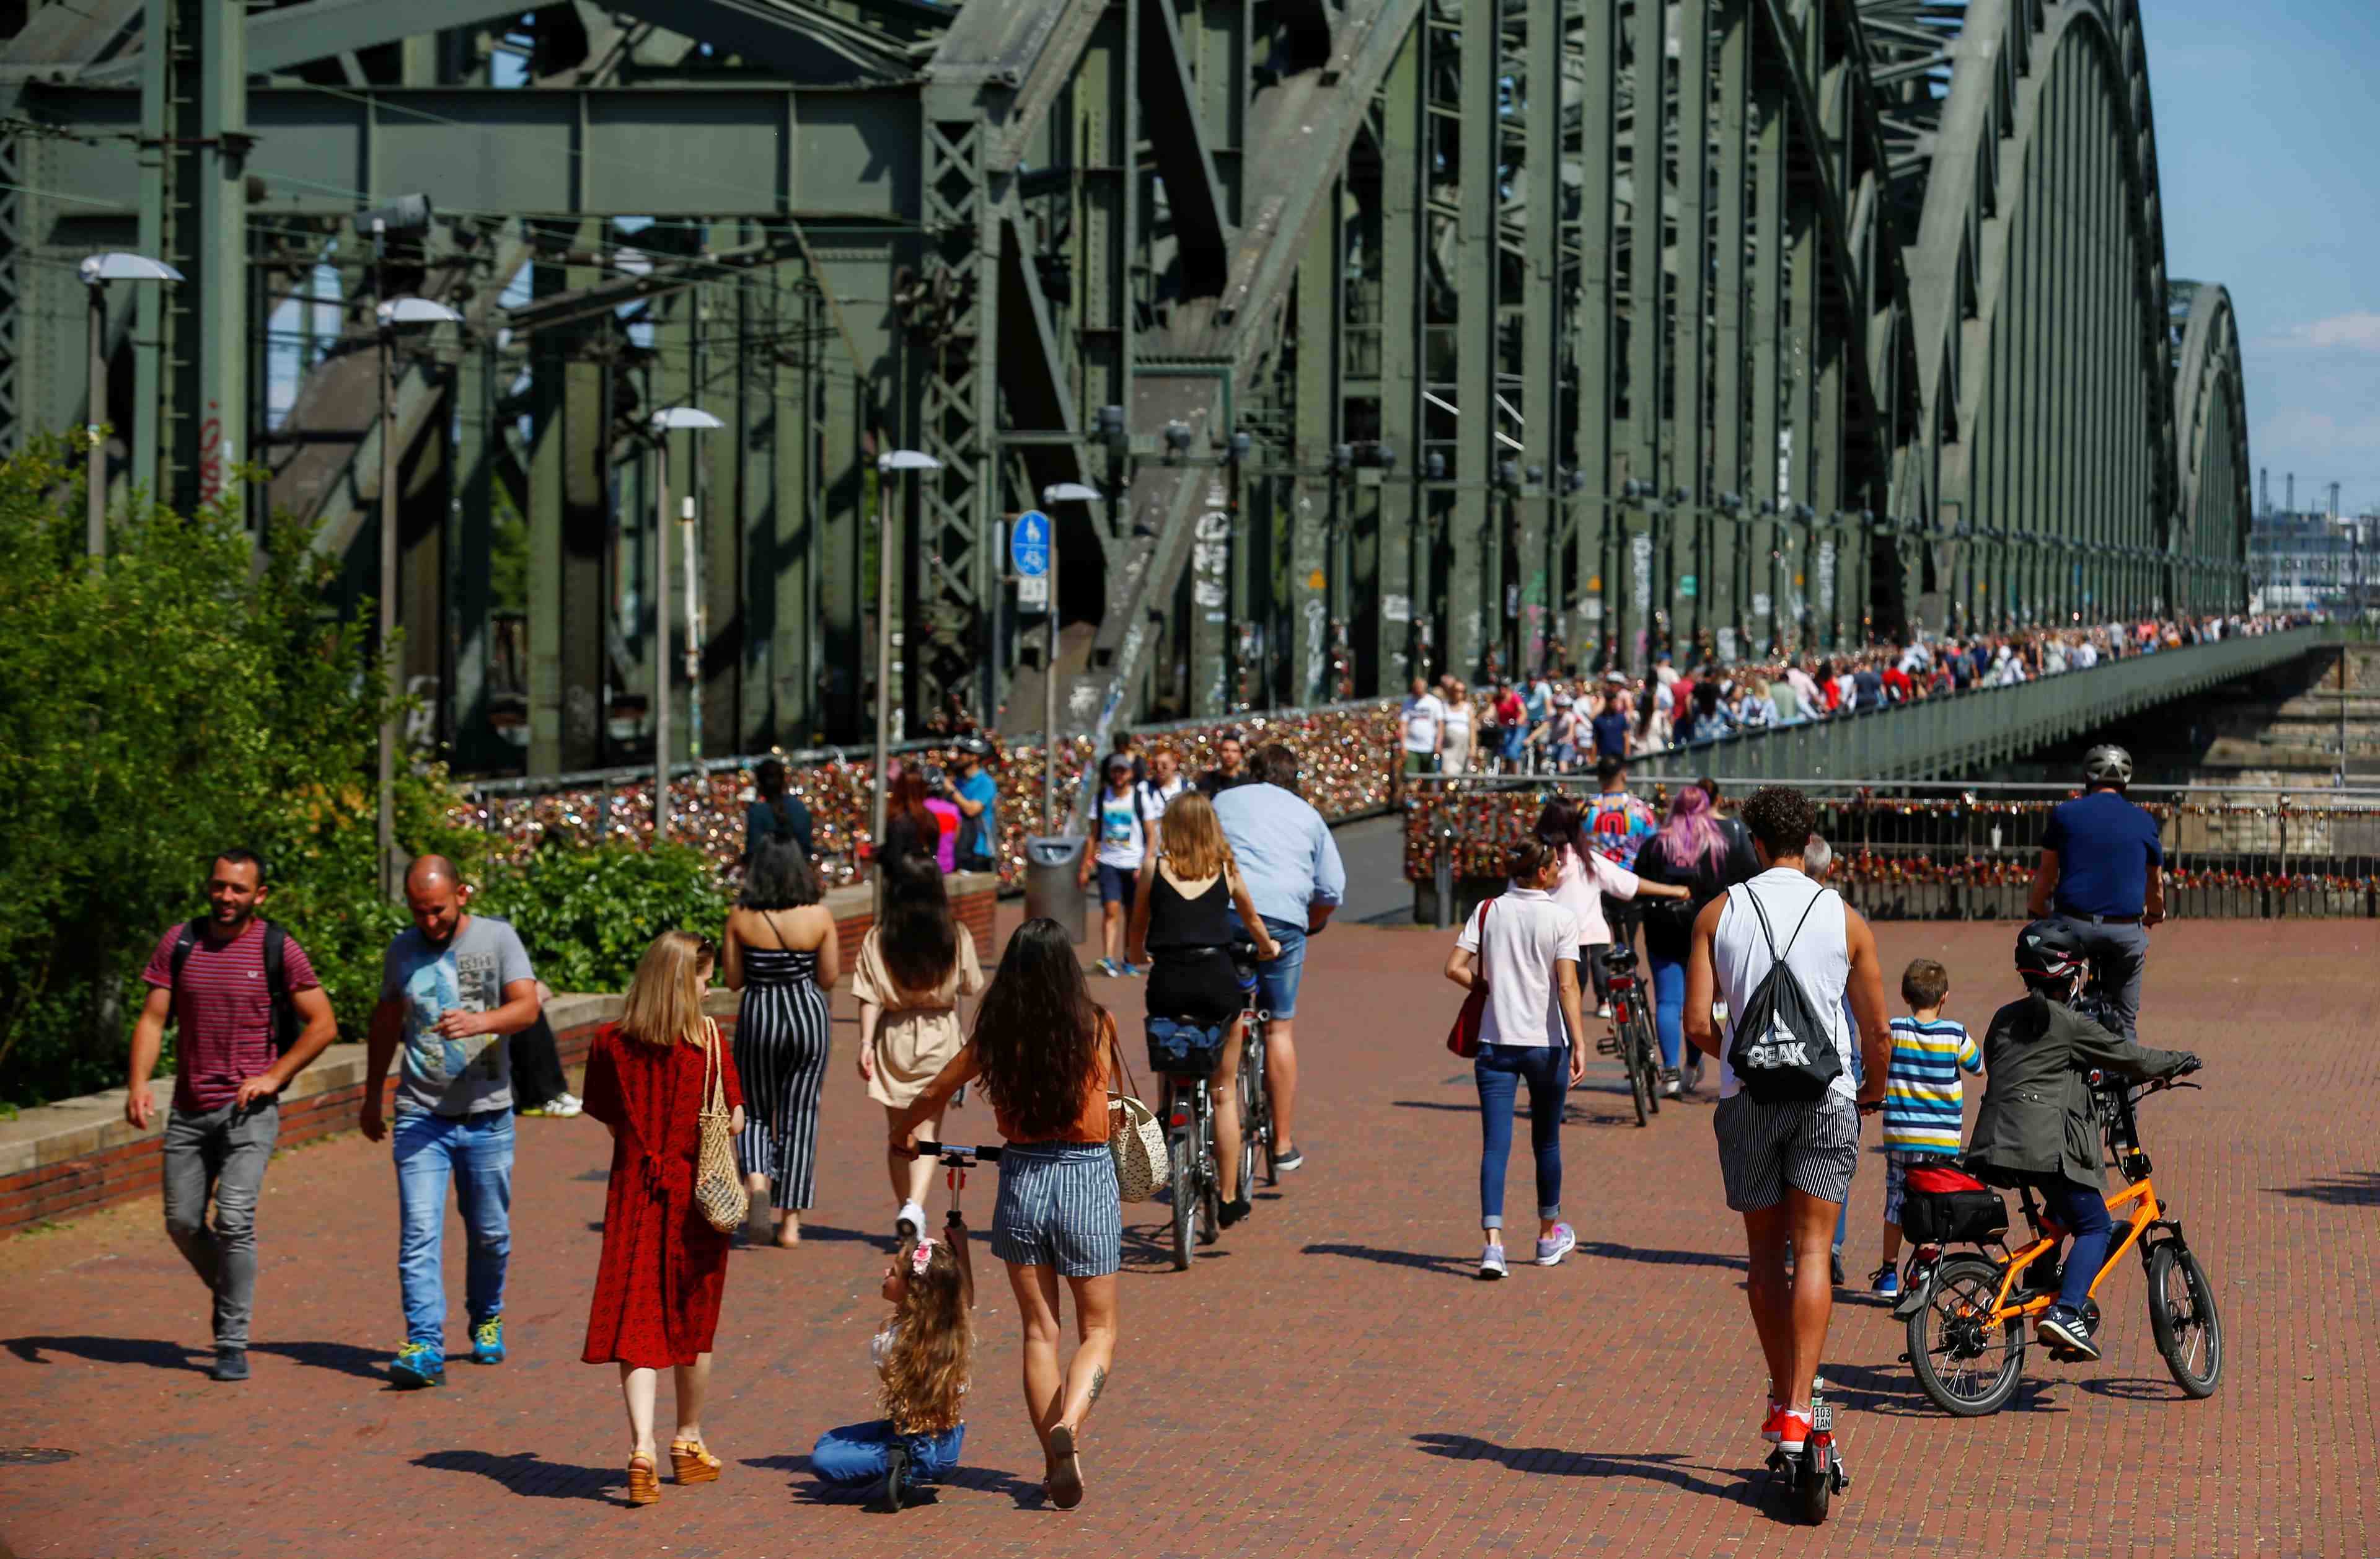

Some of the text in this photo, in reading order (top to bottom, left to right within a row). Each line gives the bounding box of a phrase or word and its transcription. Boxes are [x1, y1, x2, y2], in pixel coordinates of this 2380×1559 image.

[1747, 1042, 1811, 1069] PEAK
[1815, 1408, 1830, 1418] 103
[1815, 1419, 1830, 1428] IAN
